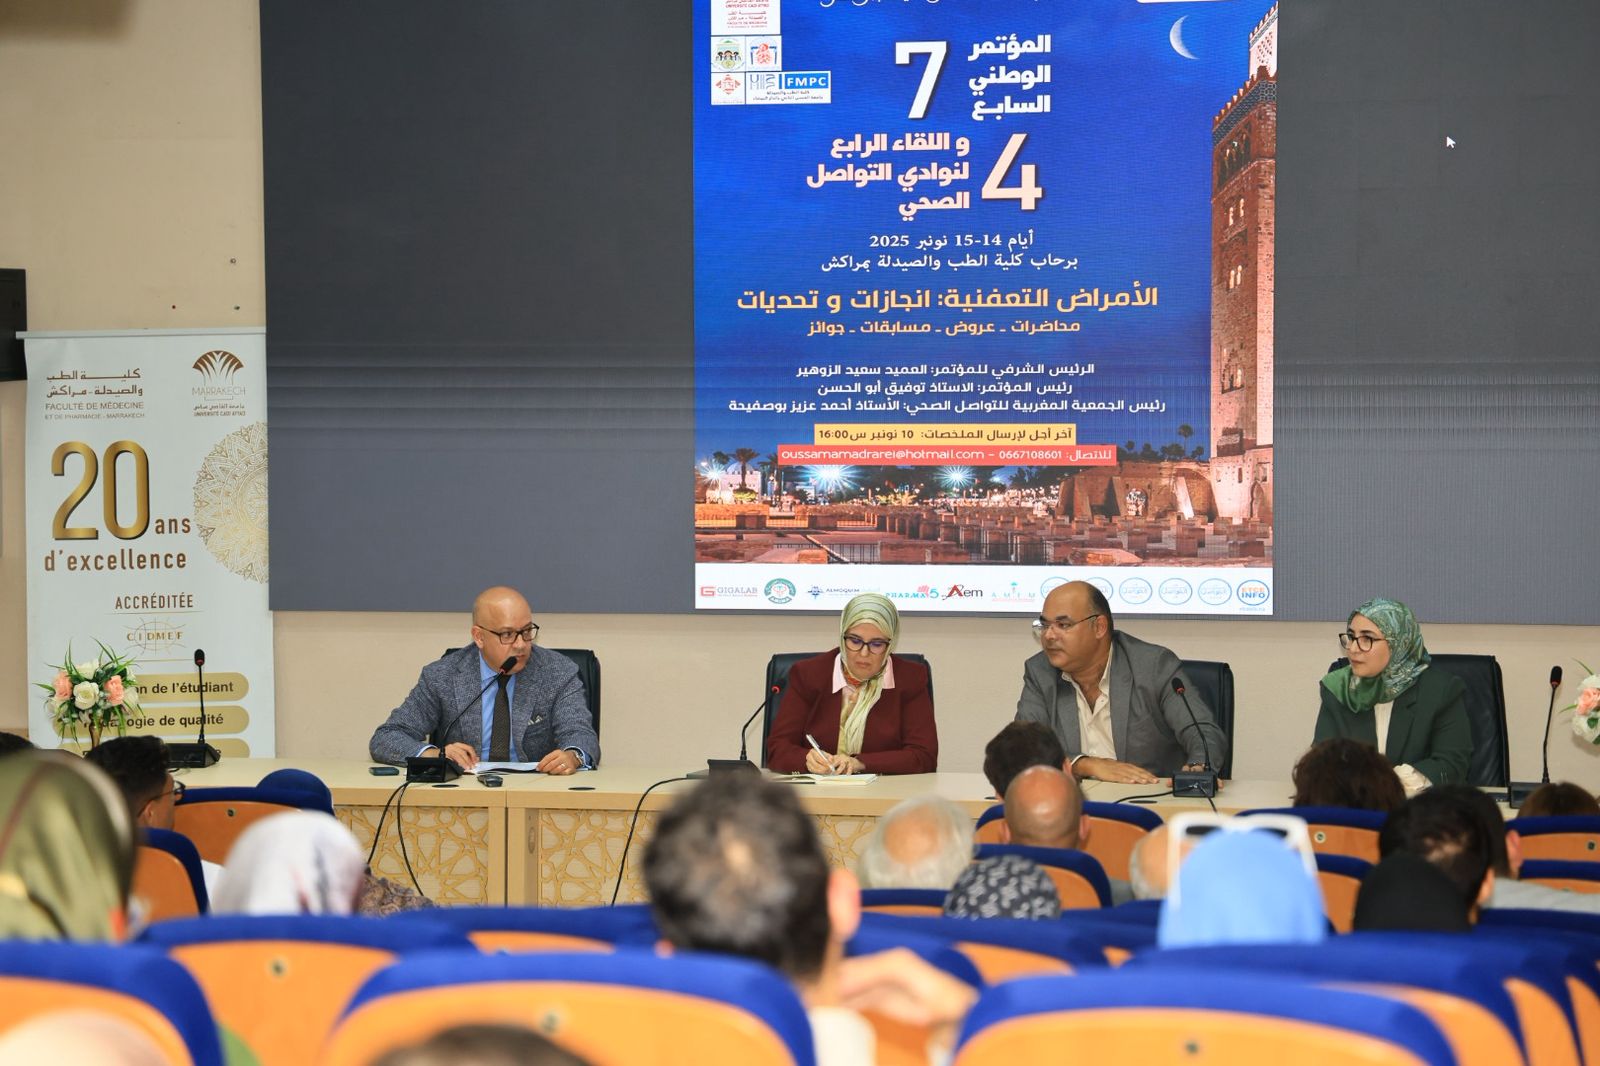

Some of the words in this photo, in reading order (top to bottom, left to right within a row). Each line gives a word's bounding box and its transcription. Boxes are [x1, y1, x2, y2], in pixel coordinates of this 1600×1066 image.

[967, 33, 1052, 61] المؤتمر
[787, 77, 826, 86] FMPC
[895, 41, 947, 119] 7
[968, 64, 1051, 96] الوطني
[971, 94, 1051, 121] السابع
[830, 133, 888, 158] الرابع
[892, 132, 950, 151] اللقاء
[955, 137, 970, 157] و
[806, 162, 892, 188] التواصل
[897, 161, 970, 192] لنوادي
[981, 133, 1043, 210] 4
[898, 191, 970, 222] الصحي
[869, 235, 910, 247] 2025
[915, 233, 948, 250] نونبر
[1008, 229, 1034, 252] أيام
[821, 255, 871, 272] بمراكش
[877, 254, 941, 272] والصيدلة
[948, 254, 987, 272] الطب
[994, 252, 1024, 272] كلية
[1030, 253, 1078, 270] برحاب
[737, 290, 819, 314] تحديات
[850, 289, 930, 313] انجازات
[1056, 280, 1158, 312] الأمراض
[826, 294, 841, 314] و
[807, 320, 845, 337] جوائز
[860, 320, 930, 337] مسابقات
[945, 321, 995, 336] عروض
[1011, 320, 1080, 336] محاضرات
[46, 370, 78, 382] الطب
[796, 364, 841, 378] الزوهير
[845, 366, 880, 377] سعيد
[885, 364, 927, 377] العميد
[991, 362, 1044, 380] الشرفي
[1049, 363, 1094, 376] الرئيس
[817, 382, 860, 395] الحسن
[865, 380, 880, 395] أبو
[884, 382, 926, 395] توفيق
[1036, 382, 1073, 395] رئيس
[46, 402, 83, 410] FACULTÉ
[86, 402, 97, 410] DE
[100, 401, 144, 409] MÉDECINE
[728, 400, 787, 413] بوصفيحة
[789, 400, 816, 413] عزيز
[820, 398, 851, 411] أحمد
[855, 398, 899, 410] الأستاذ
[954, 400, 1008, 413] للتواصل
[1012, 400, 1068, 413] المغربية
[1071, 400, 1124, 413] الجمعية
[1129, 399, 1166, 413] رئيس
[869, 429, 897, 440] نونبر
[902, 430, 914, 439] 10
[986, 429, 1026, 441] لإرسال
[1029, 427, 1051, 441] أجل
[1054, 427, 1072, 441] آخر
[999, 450, 1062, 459] 0667108601
[52, 440, 150, 540] 20
[154, 517, 191, 534] ans
[115, 592, 194, 609] ACCRÉDITÉE
[127, 631, 184, 641] CIDMEF
[152, 684, 168, 693] de
[159, 715, 175, 726] de
[180, 714, 224, 728] qualité
